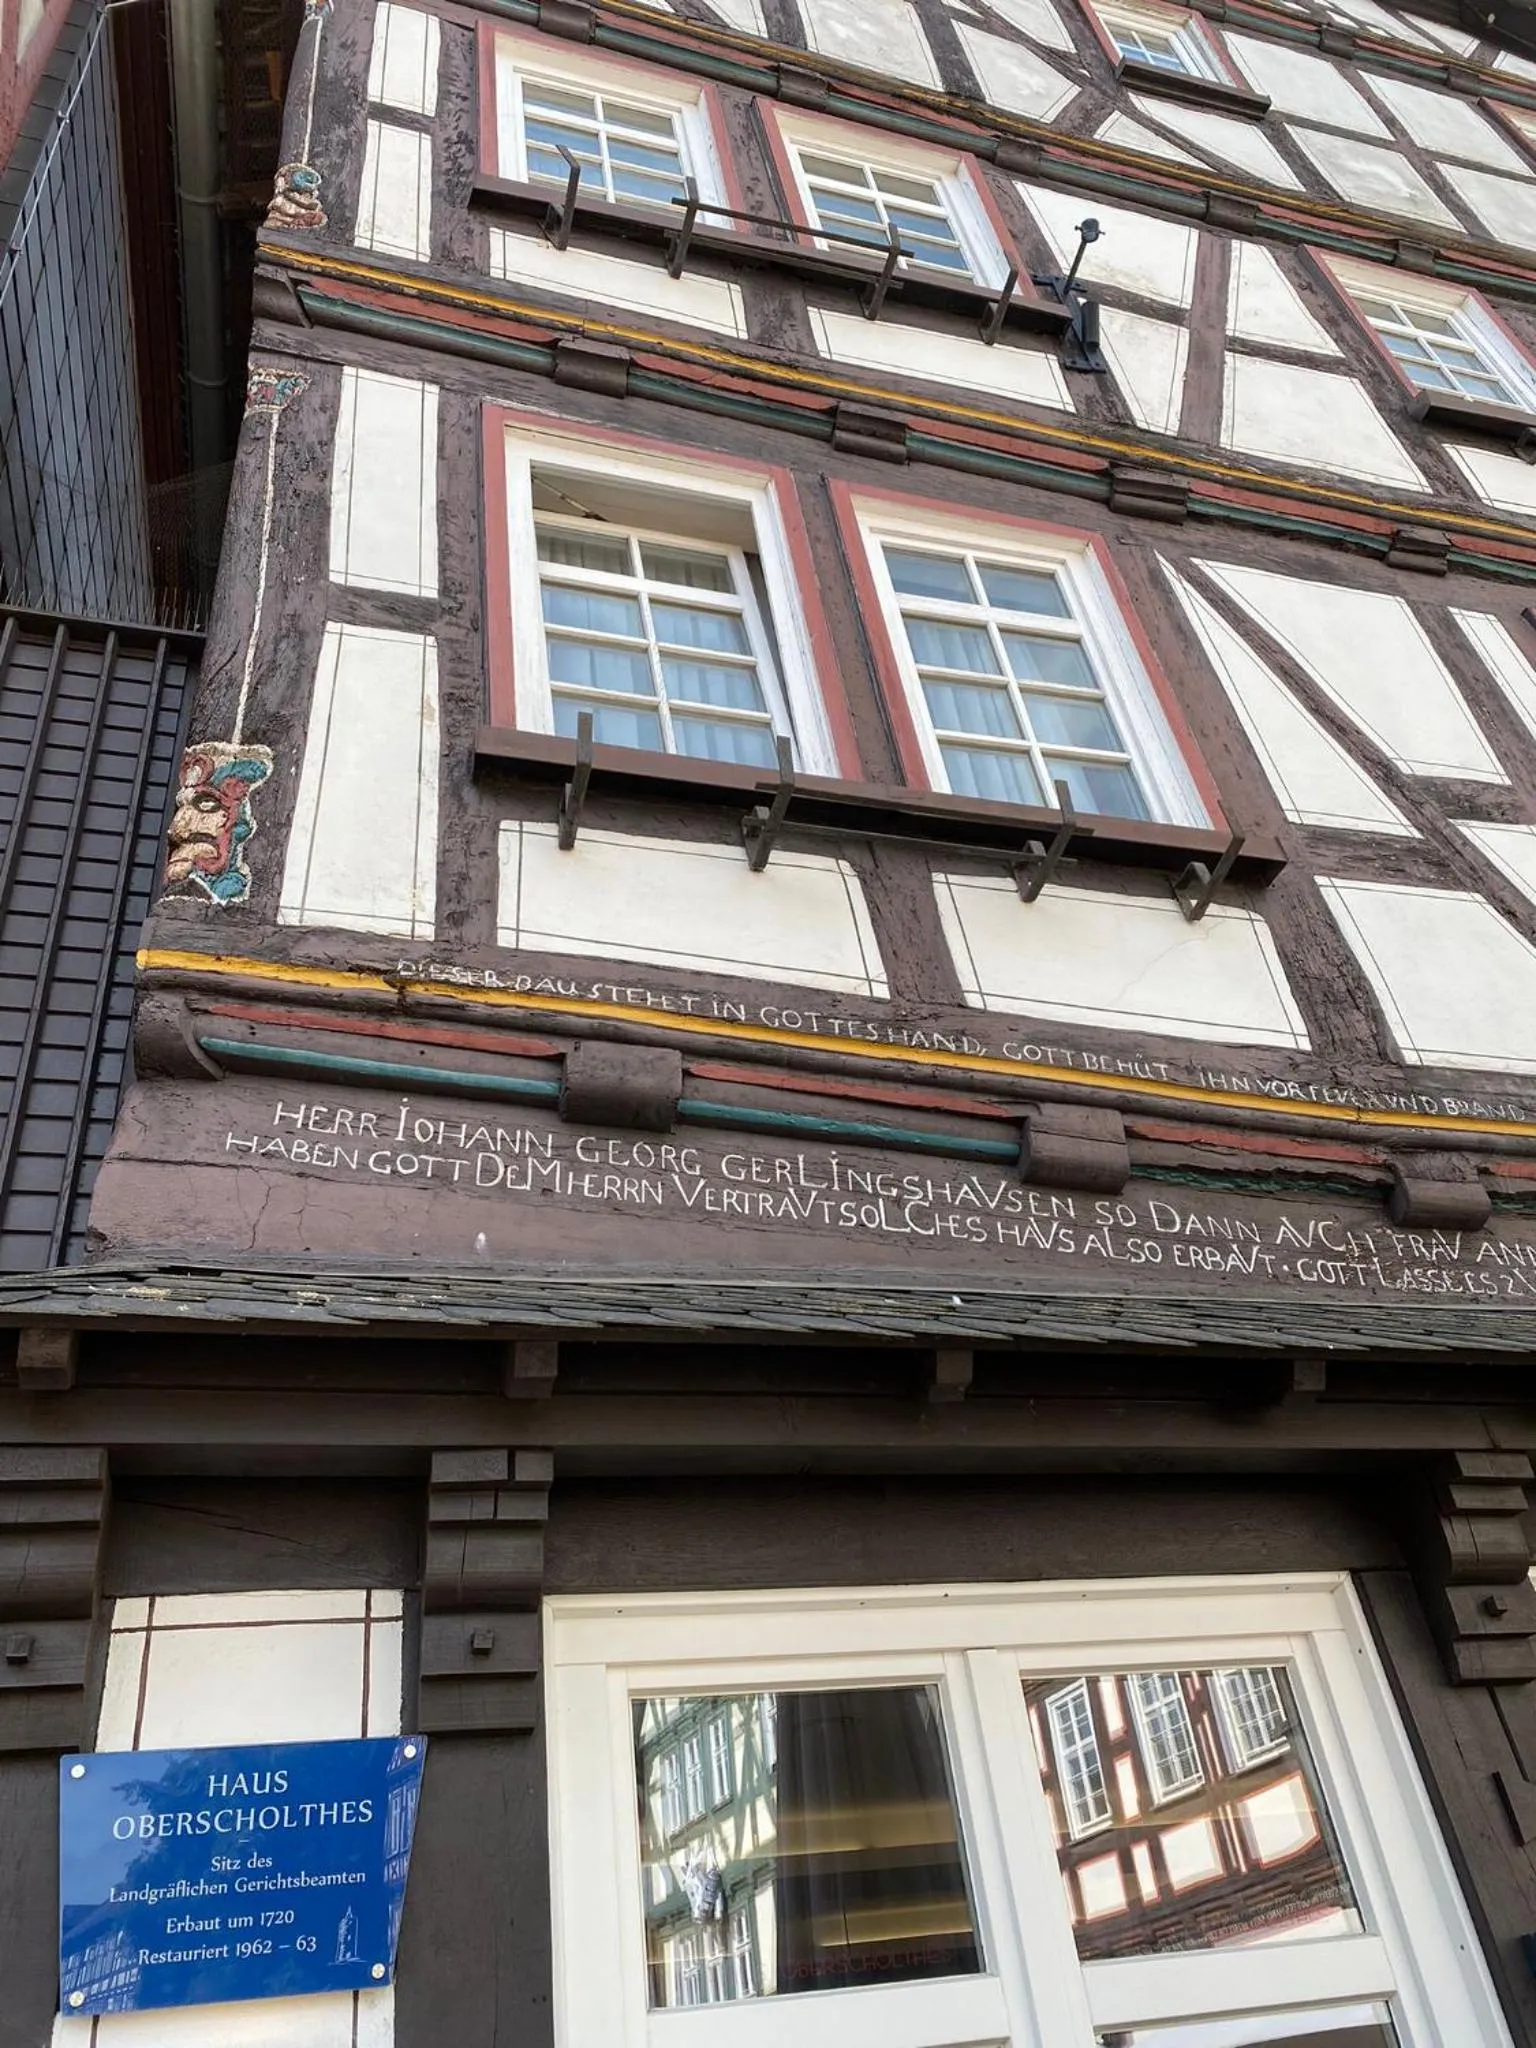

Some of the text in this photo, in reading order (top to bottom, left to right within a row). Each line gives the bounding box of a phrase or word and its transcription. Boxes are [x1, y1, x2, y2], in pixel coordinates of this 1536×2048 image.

[1003, 1041, 1075, 1068] GOTT
[272, 1100, 378, 1139] HERR
[575, 1134, 702, 1176] GEORG
[1095, 1200, 1138, 1227] SO
[1149, 1200, 1261, 1244] DANN
[1391, 1228, 1463, 1262] FRAV
[225, 1131, 358, 1169] HABEN
[367, 1150, 471, 1182] GOTT
[566, 1170, 664, 1206] HERRN
[996, 1215, 1076, 1254] HAVS
[1083, 1226, 1163, 1264] ALSO
[1296, 1257, 1367, 1287] GOTT
[207, 1769, 290, 1799] HAUS
[111, 1799, 374, 1841] OBERSCHOLTHES
[210, 1852, 274, 1873] Sitz des
[109, 1870, 367, 1904] Landgräflichen Gerichtsbeamten
[166, 1909, 296, 1935] Erbaut um 1720
[137, 1944, 230, 1966] Restauriert
[235, 1939, 273, 1959] 1962
[295, 1935, 318, 1953] 63
